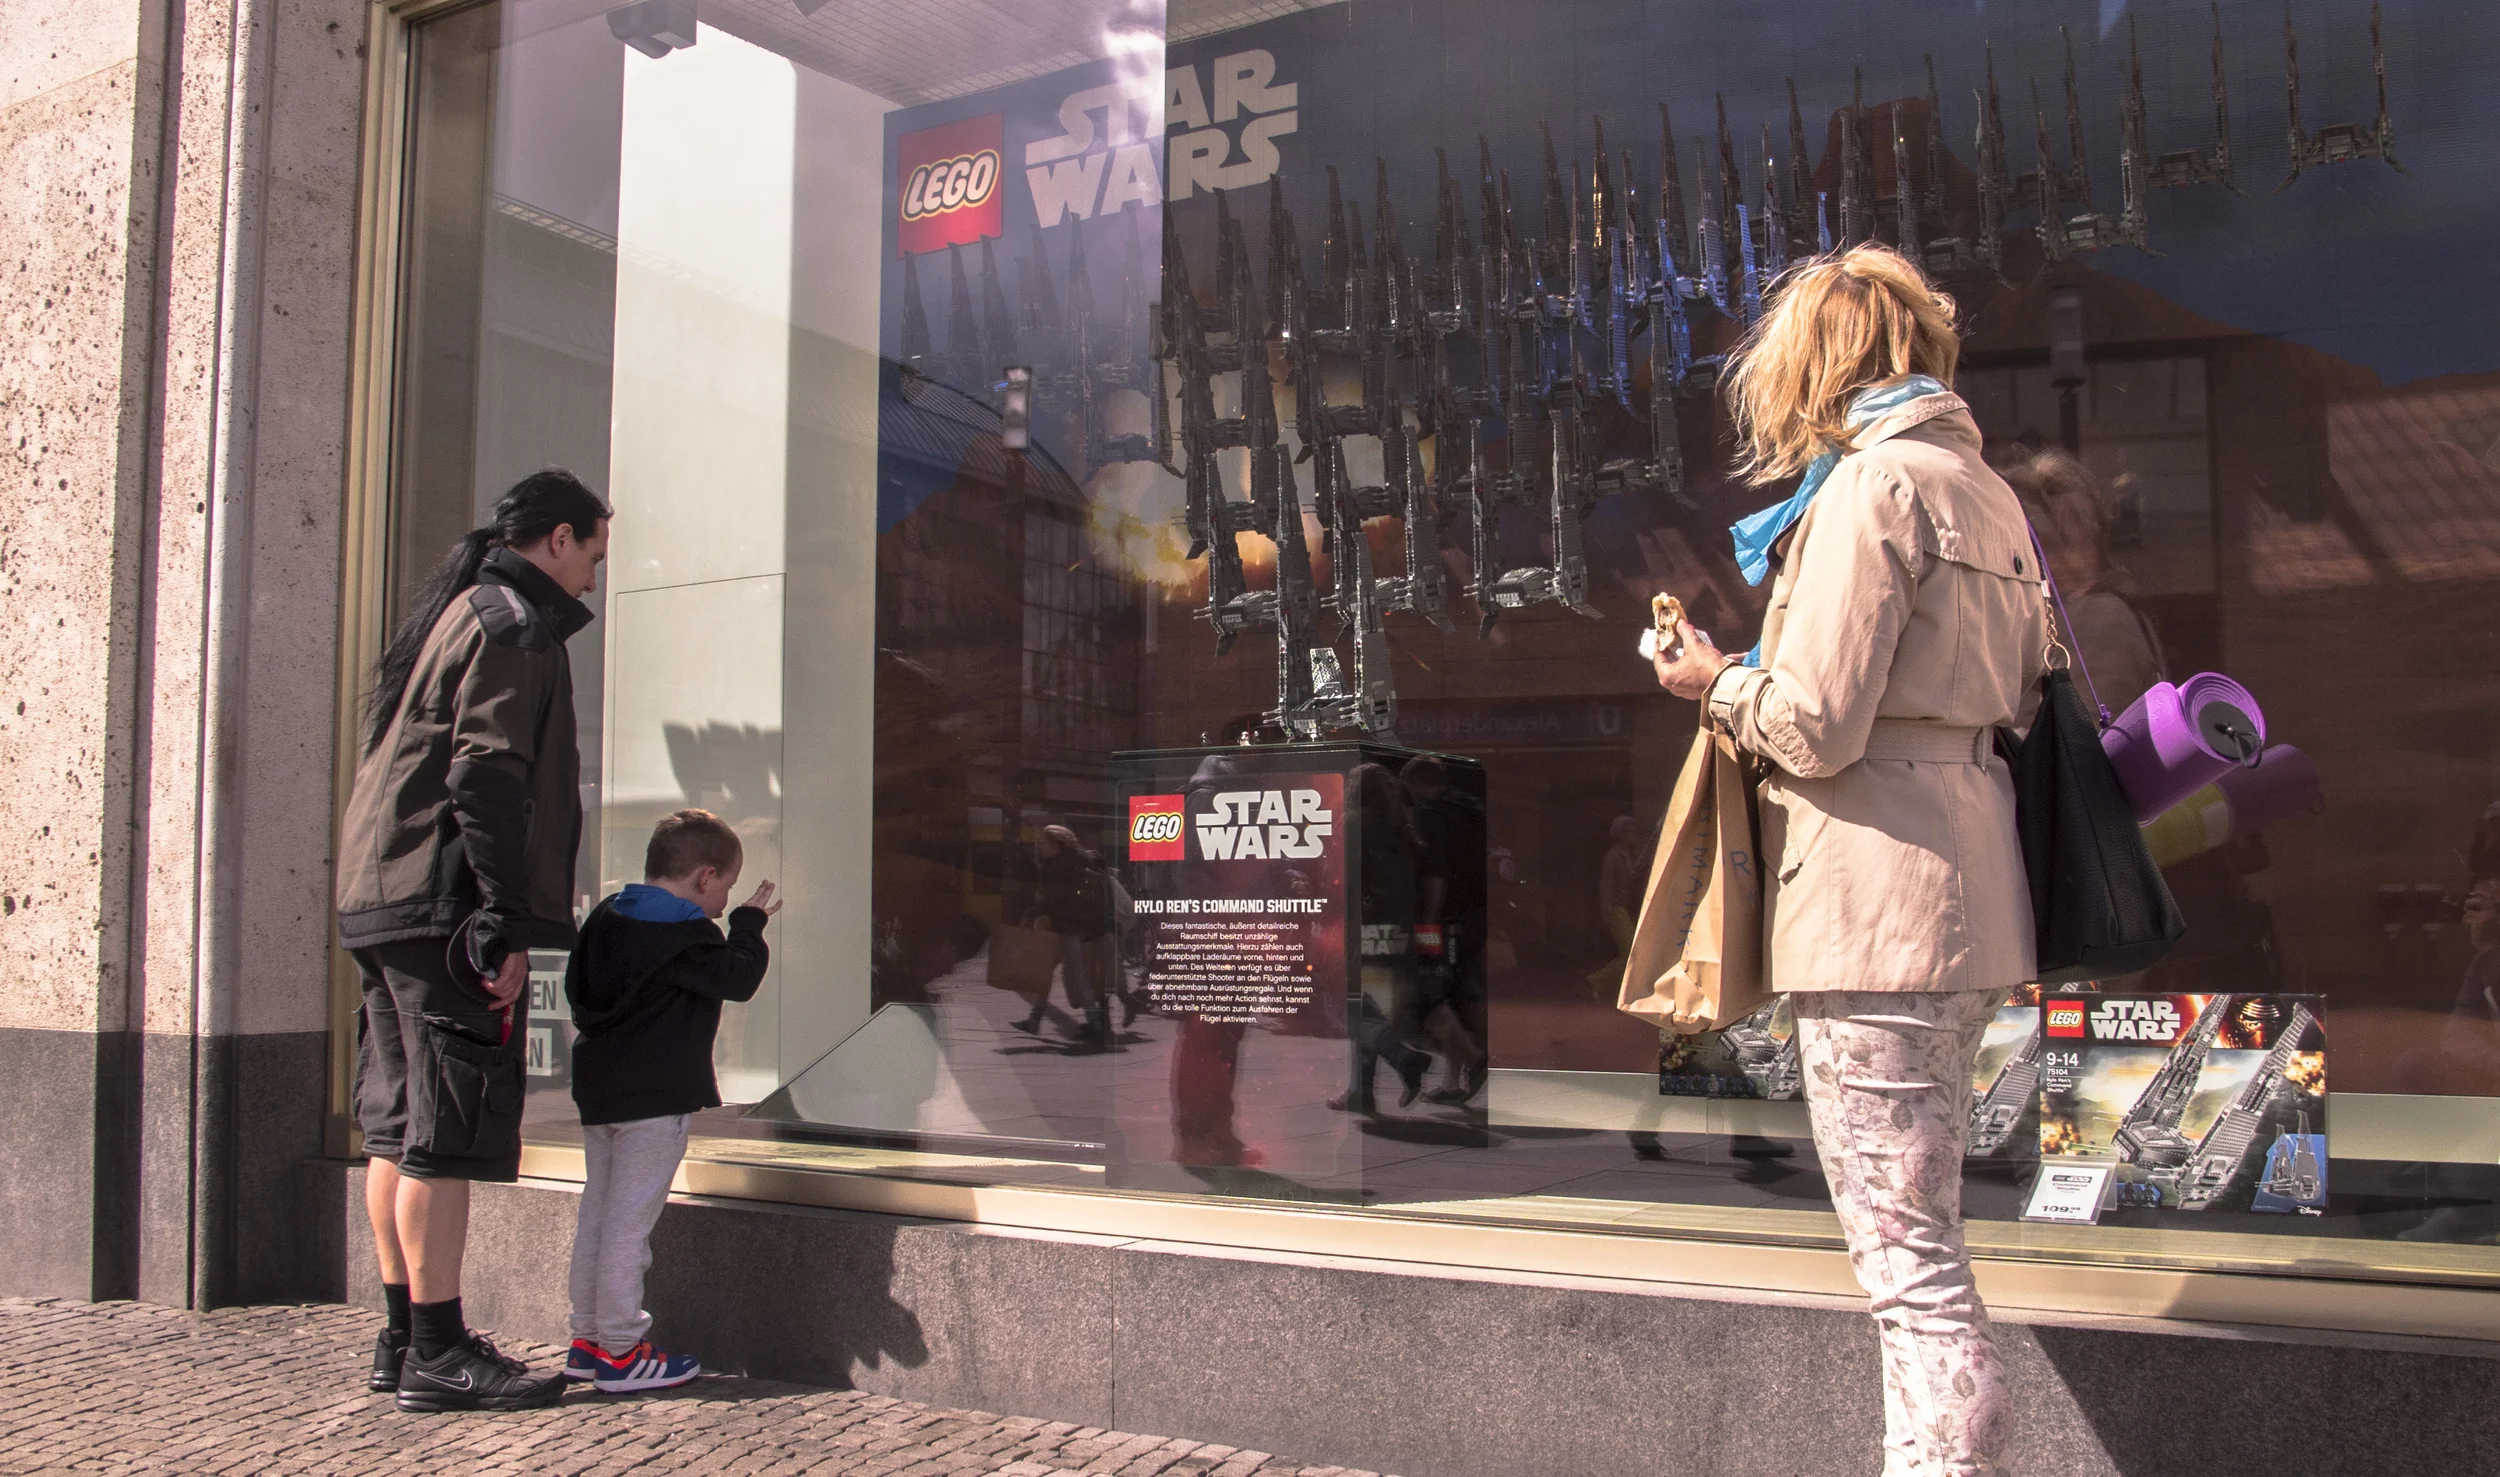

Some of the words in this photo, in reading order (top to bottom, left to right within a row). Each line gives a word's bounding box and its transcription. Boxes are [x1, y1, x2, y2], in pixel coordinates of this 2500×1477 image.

[1026, 49, 1298, 165] STAR
[1026, 110, 1298, 228] WARS
[902, 149, 1000, 221] LEGO
[1196, 789, 1332, 826] STAR
[1132, 812, 1184, 843] LEGO
[1196, 824, 1332, 861] WARS
[1134, 900, 1163, 913] KYLO
[1203, 900, 1264, 913] COMMAND
[1161, 922, 1183, 930] Dieses
[1229, 922, 1256, 930] äußerst
[1258, 922, 1299, 930] detailreiche
[1181, 932, 1218, 940] Raumschiff
[1220, 932, 1243, 940] besitzt
[1244, 932, 1278, 942] unzählige
[1156, 942, 1235, 953] Ausstattungsmerkmale.
[1237, 943, 1259, 951] Hierzu
[1261, 943, 1284, 951] zählen
[1285, 943, 1303, 951] auch
[1156, 953, 1200, 963] aufklappbare
[1203, 953, 1241, 961] Laderäume
[1243, 954, 1264, 962] vorne,
[1168, 963, 1188, 971] unten.
[1190, 963, 1204, 971] Des
[1206, 963, 1236, 971] Weiteren
[1237, 964, 1262, 973] verfügt
[1274, 964, 1291, 972] über
[1149, 973, 1206, 982] federunterstützte
[1208, 974, 1235, 982] Shooter
[1247, 974, 1261, 982] den
[1263, 974, 1289, 984] Flügeln
[1291, 975, 1311, 983] sowie
[1148, 983, 1163, 991] über
[1165, 983, 1208, 992] abnehmbare
[1210, 984, 1275, 994] Ausrüstungsregale.
[1277, 984, 1292, 993] Und
[1151, 993, 1160, 1001] du
[1162, 993, 1176, 1001] dich
[1178, 993, 1194, 1002] nach
[1196, 994, 1214, 1002] noch
[1215, 994, 1233, 1002] mehr
[1234, 994, 1257, 1003] Action
[1259, 995, 1284, 1004] sehnst,
[1285, 995, 1309, 1003] kannst
[1173, 1004, 1183, 1012] die
[1185, 1004, 1199, 1012] tolle
[1201, 1004, 1230, 1012] Funktion
[1249, 1005, 1284, 1014] Ausfahren
[1285, 1006, 1298, 1014] der
[2090, 1000, 2180, 1020] STAR
[1200, 1015, 1221, 1024] Flügel
[1223, 1015, 1257, 1024] aktivieren.
[2048, 1009, 2083, 1027] LEGO
[2090, 1019, 2180, 1040] WARS
[2046, 1052, 2079, 1066] 9-14
[2046, 1068, 2068, 1076] 75104
[2297, 1206, 2322, 1217] Disney
